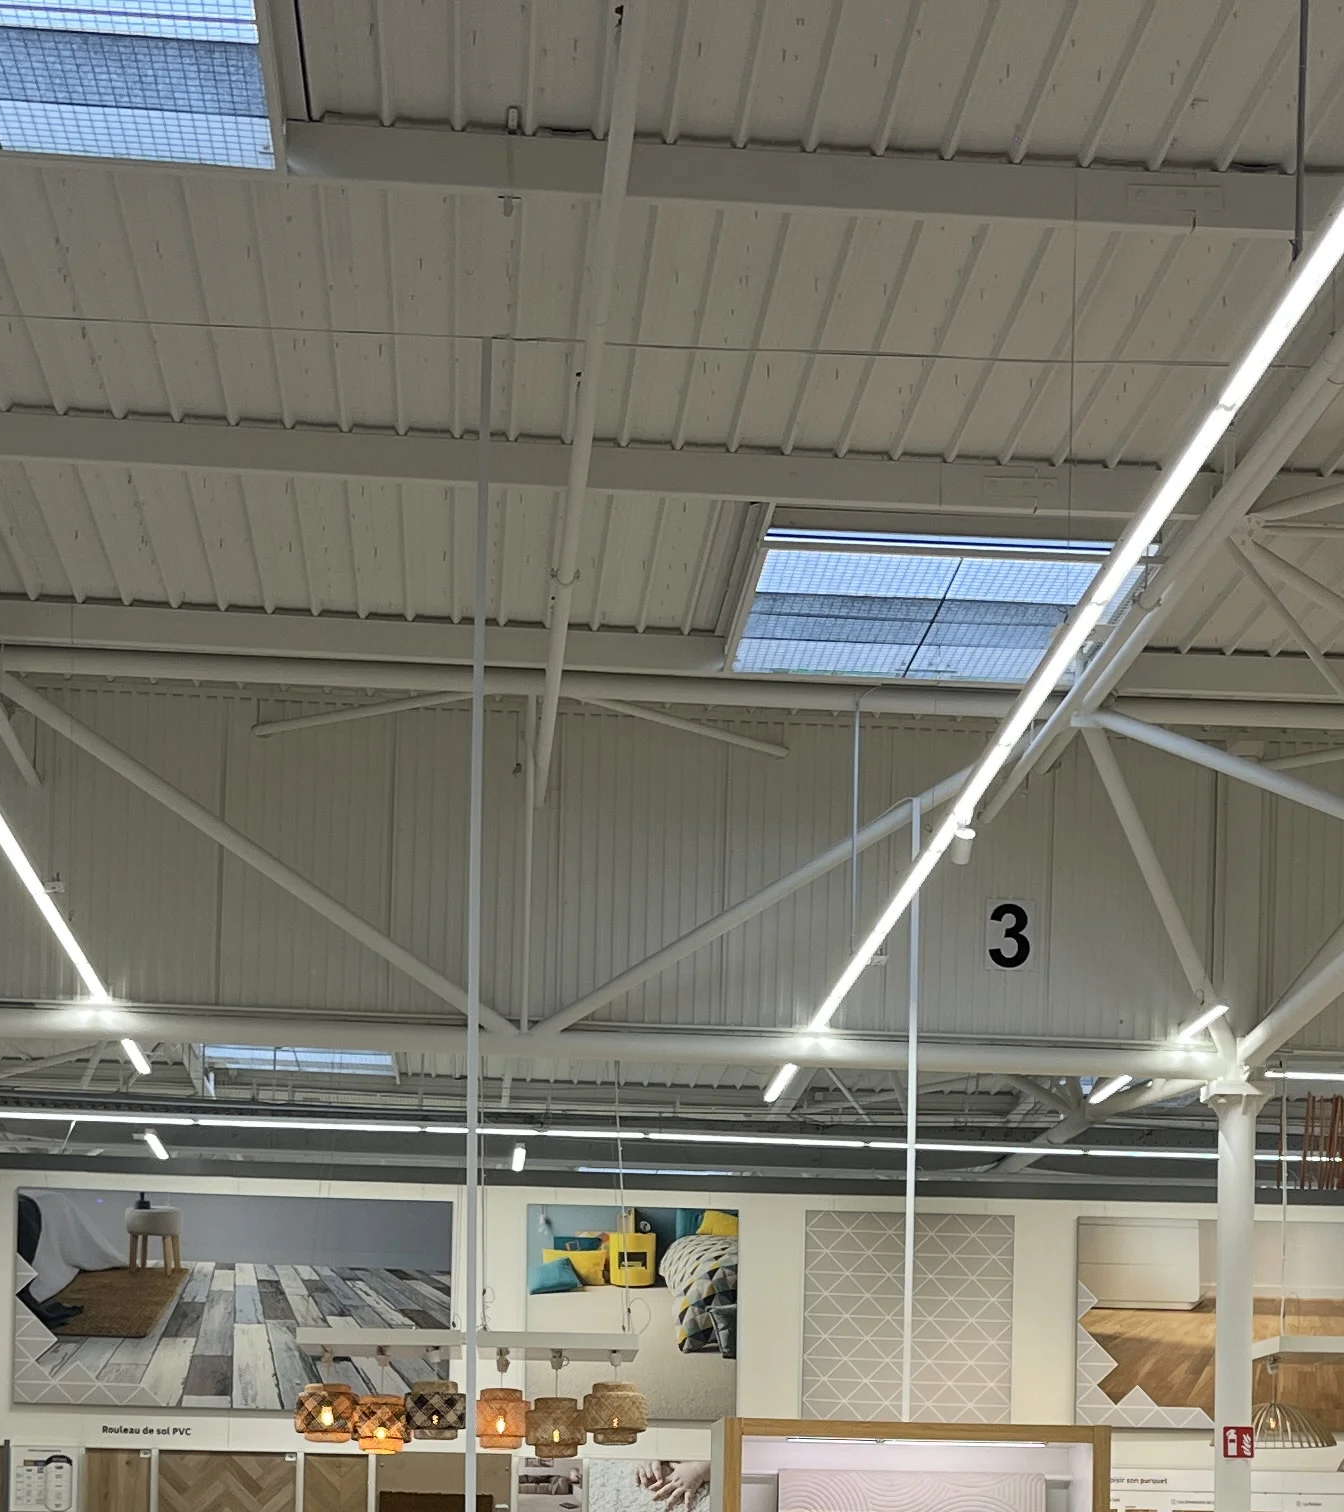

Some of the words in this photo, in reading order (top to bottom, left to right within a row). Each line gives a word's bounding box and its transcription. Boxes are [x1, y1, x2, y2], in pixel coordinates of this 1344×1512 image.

[988, 903, 1031, 968] 3
[102, 1425, 140, 1434] Rouleau
[142, 1426, 154, 1435] de
[156, 1426, 171, 1436] sol
[172, 1427, 192, 1436] PVC
